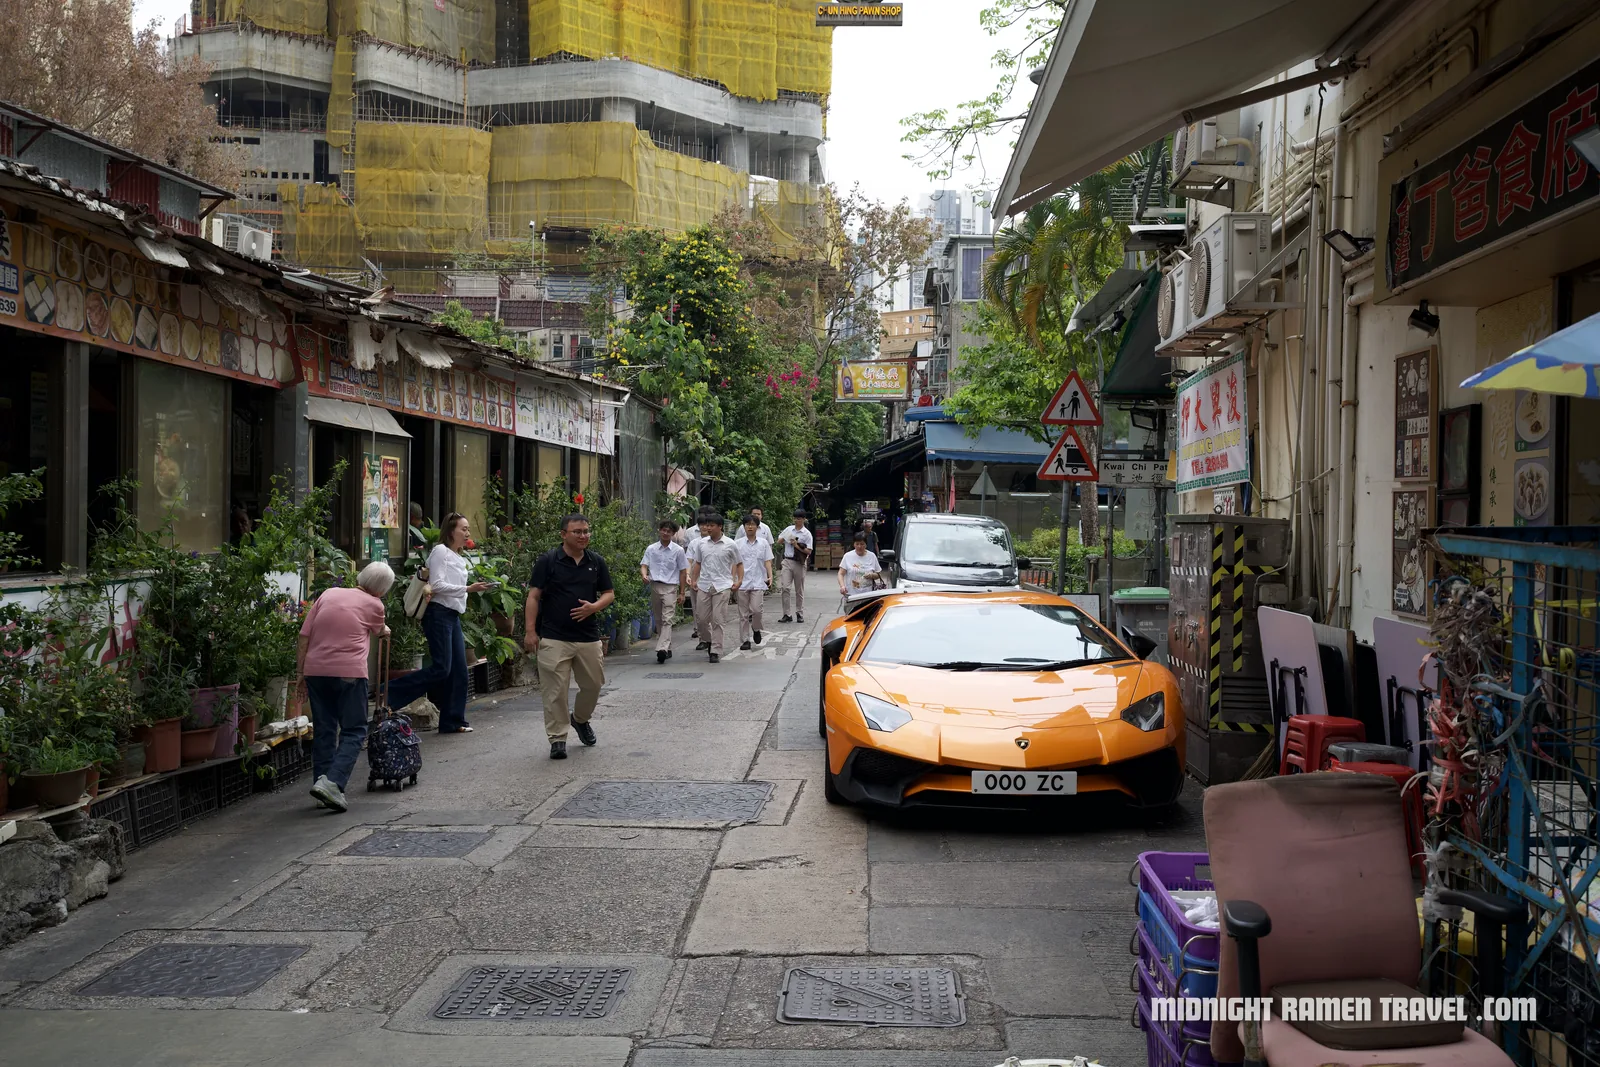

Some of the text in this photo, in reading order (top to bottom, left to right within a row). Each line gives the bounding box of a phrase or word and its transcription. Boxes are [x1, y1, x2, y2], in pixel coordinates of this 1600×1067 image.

[839, 6, 858, 16] HING
[859, 6, 880, 16] PAWN
[881, 6, 902, 16] SHOP
[1132, 463, 1147, 471] Chi
[1153, 463, 1168, 471] Pat
[1037, 775, 1064, 791] ZC
